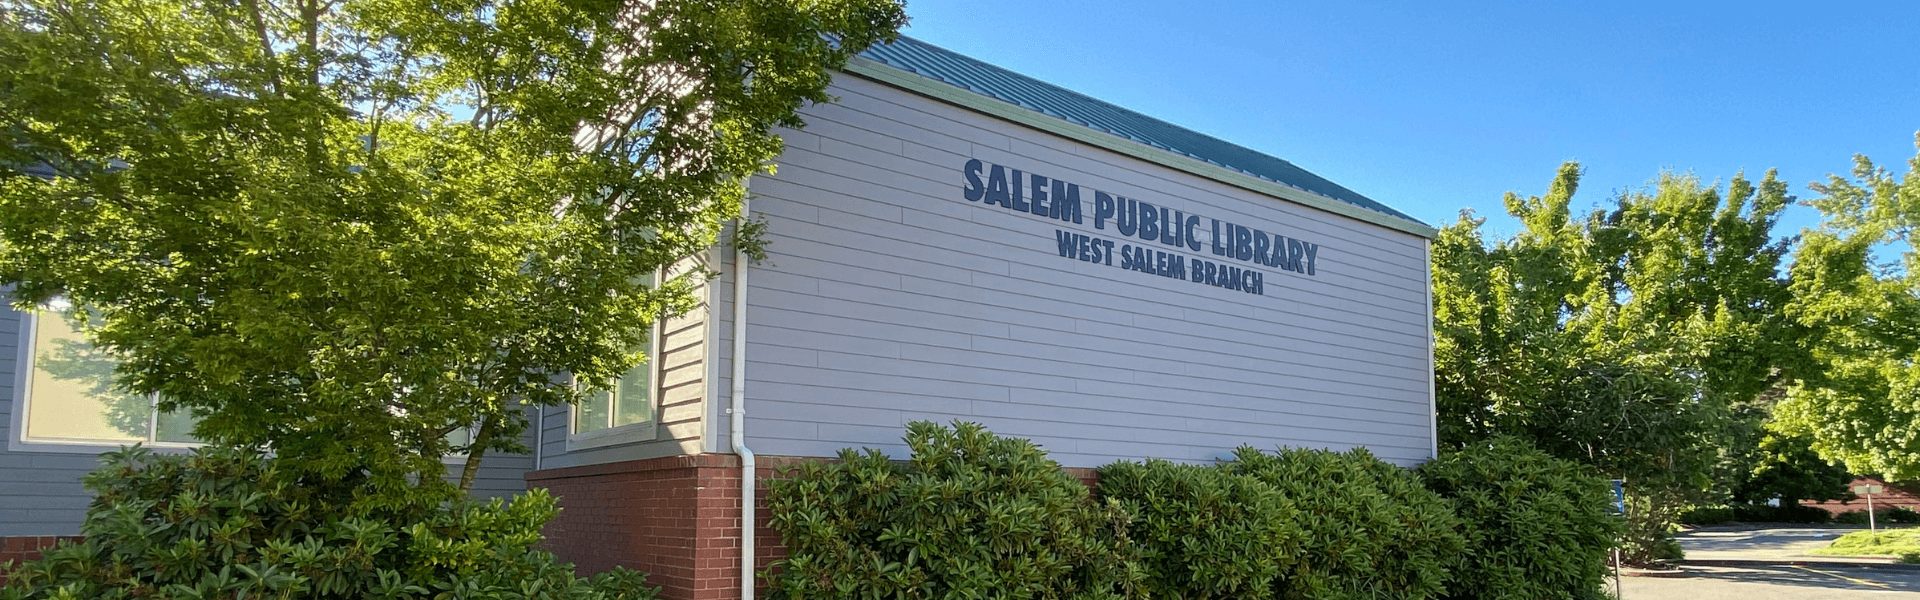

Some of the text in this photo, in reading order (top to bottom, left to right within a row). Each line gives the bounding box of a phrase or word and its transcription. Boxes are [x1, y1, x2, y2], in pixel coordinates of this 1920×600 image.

[964, 158, 1318, 275] SALEM PUBLIC LIBRARY
[1056, 229, 1263, 295] WEST SALEM BRANCH
